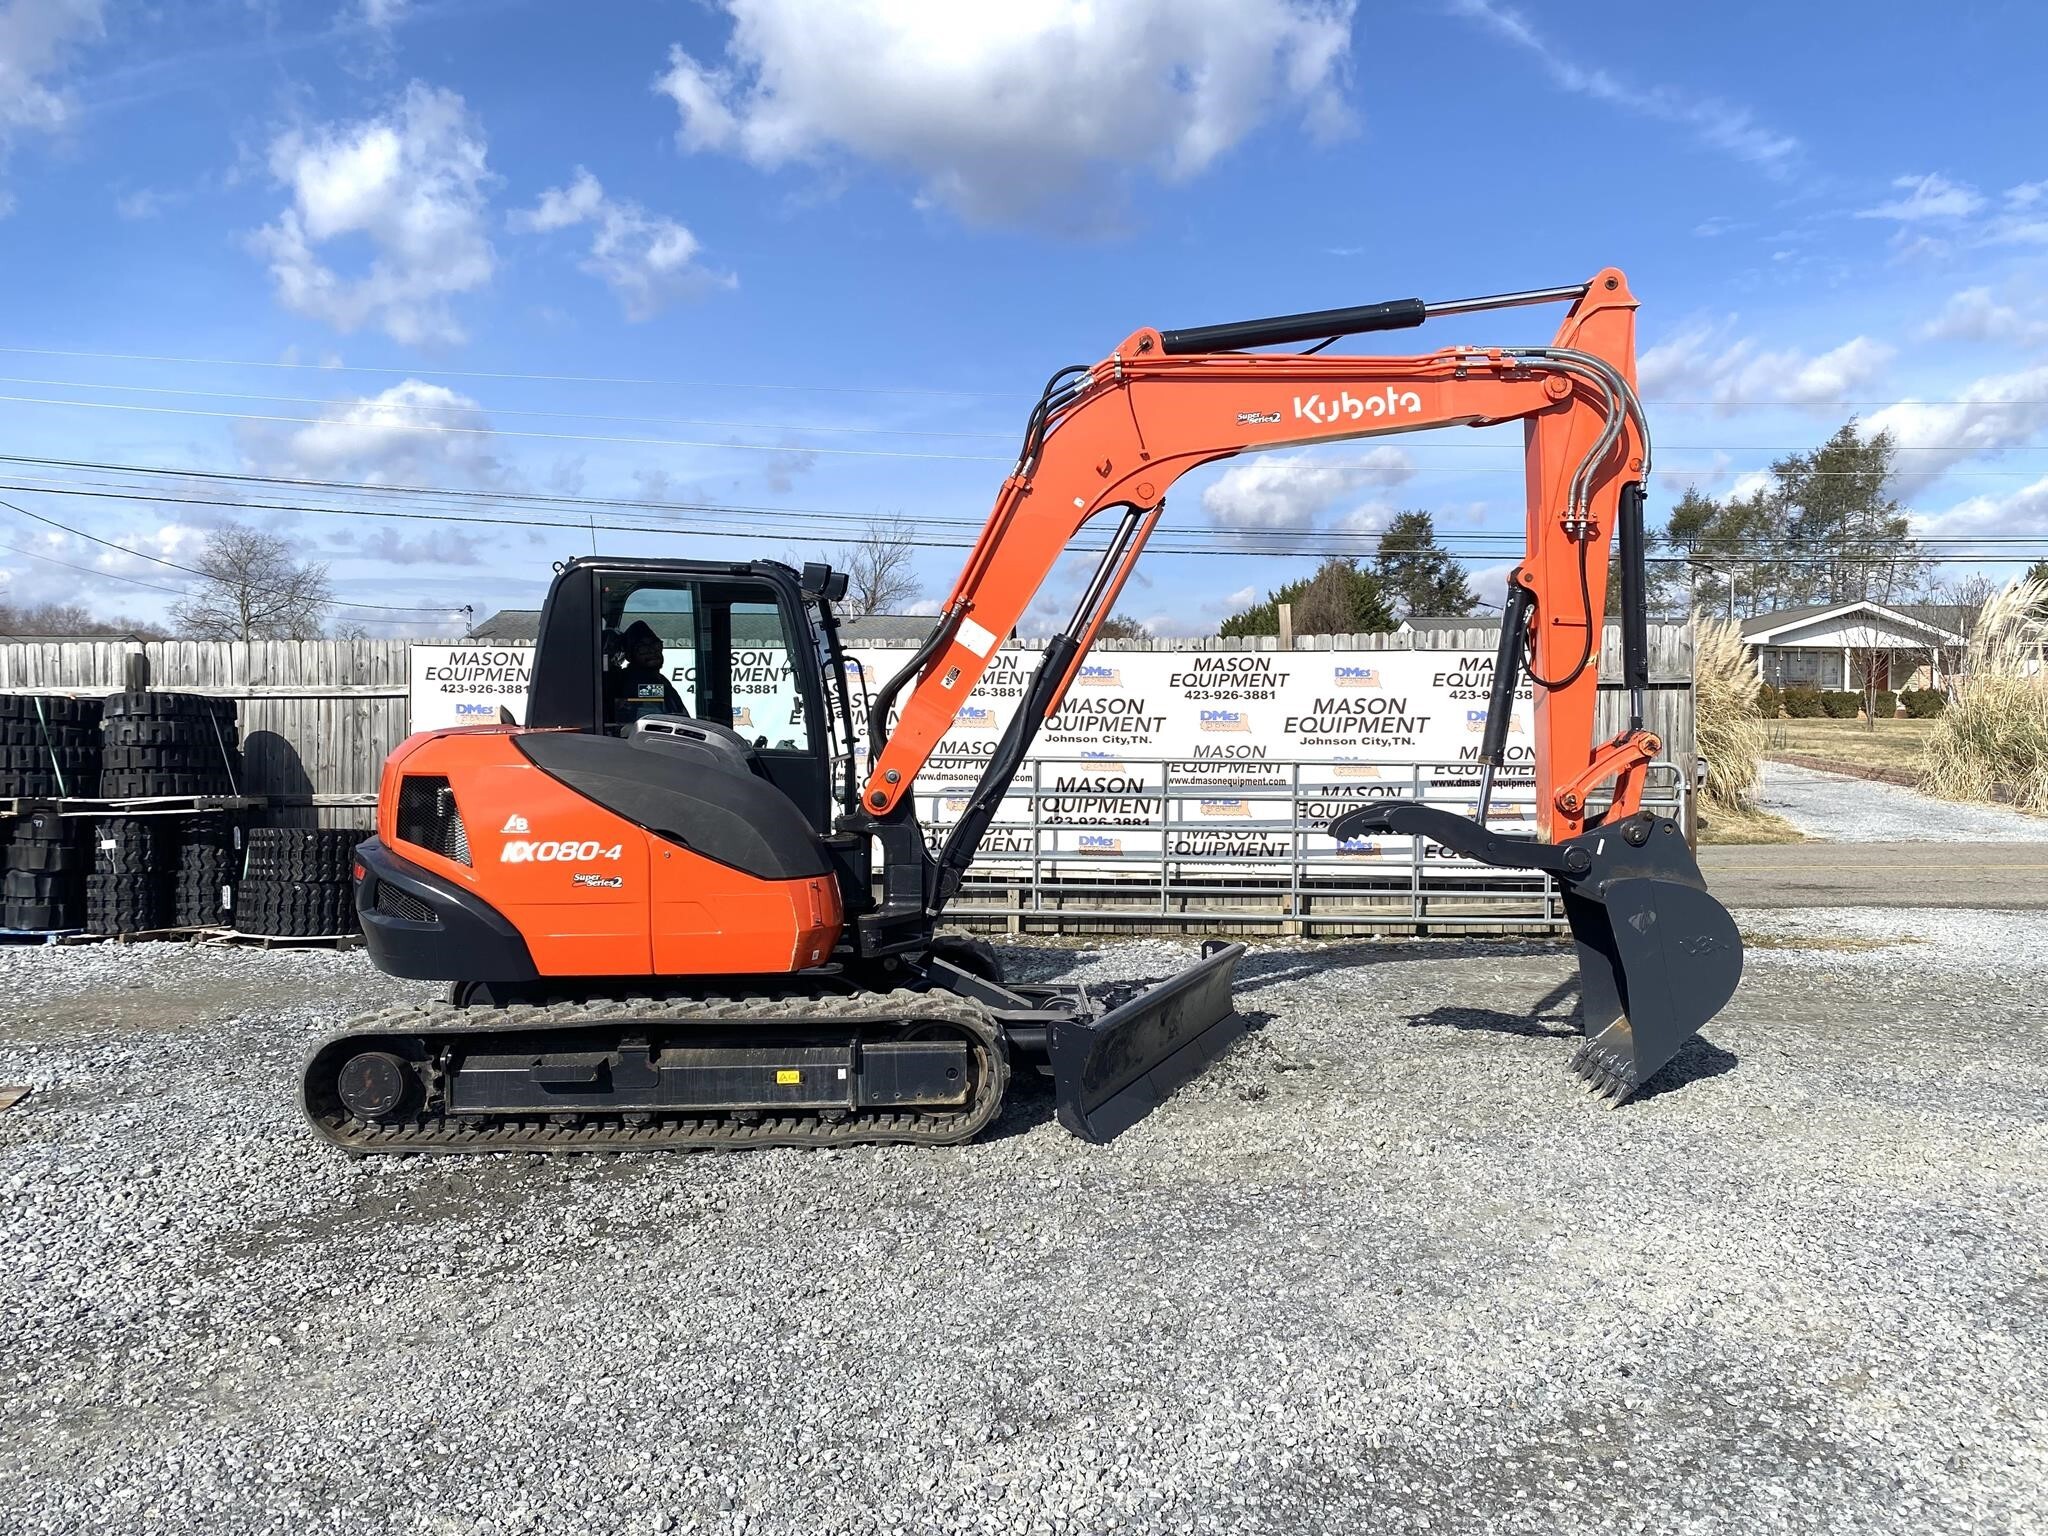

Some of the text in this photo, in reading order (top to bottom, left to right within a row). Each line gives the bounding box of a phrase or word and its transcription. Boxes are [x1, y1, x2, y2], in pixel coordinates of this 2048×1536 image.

[1293, 386, 1422, 424] Kubota
[449, 652, 525, 666] MASON
[731, 652, 773, 666] SON
[1193, 657, 1271, 671] MASON
[425, 667, 533, 682] EQUIPMEN
[1169, 673, 1290, 687] EQUIPMENT
[1184, 690, 1276, 700] 423-926-3881
[1057, 698, 1145, 714] MASON
[1313, 698, 1407, 715] MASON
[1038, 716, 1167, 732] QUIPMENT
[1283, 717, 1431, 733] EQUIPMENT
[1045, 734, 1098, 743] Johnson
[1300, 737, 1357, 745] Johnson
[939, 741, 998, 755] MASO
[1193, 745, 1267, 758] MASON
[1459, 746, 1536, 760] MON
[1055, 776, 1145, 794] MASON
[500, 840, 623, 863] KX080-4
[573, 873, 601, 882] Super
